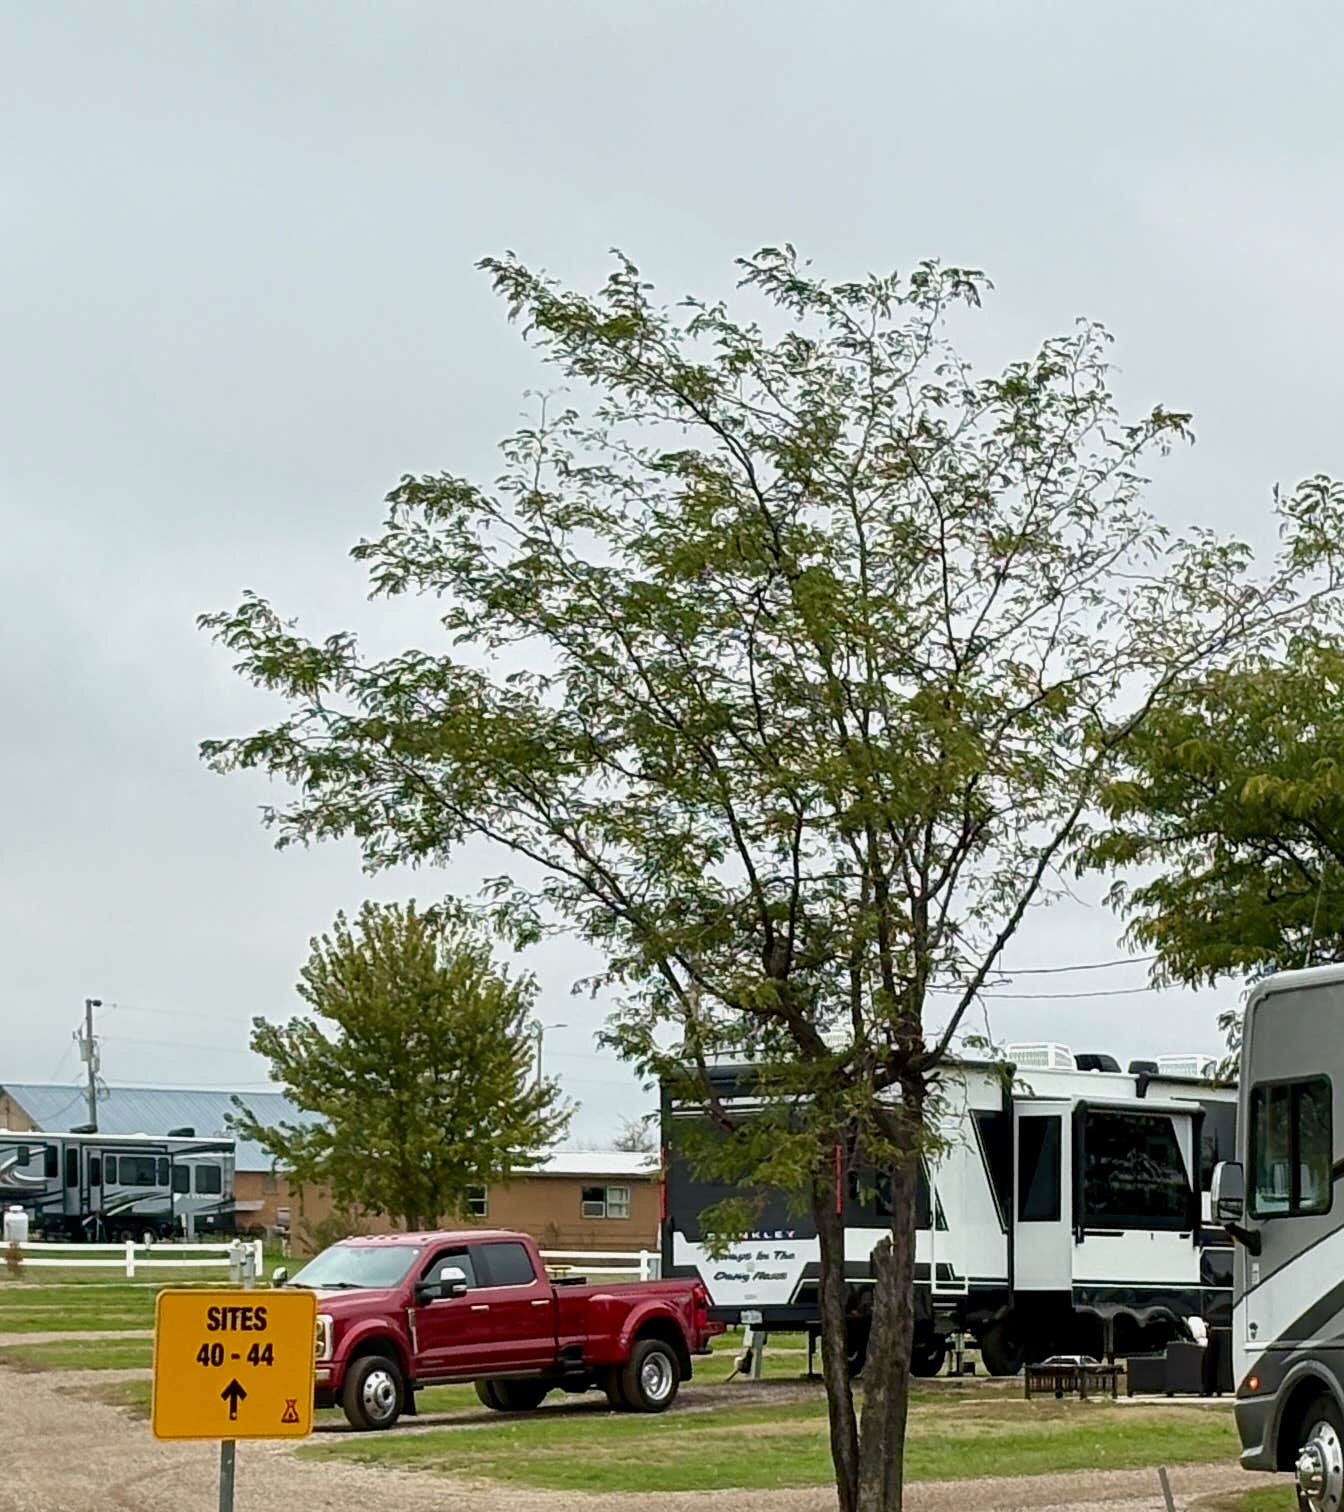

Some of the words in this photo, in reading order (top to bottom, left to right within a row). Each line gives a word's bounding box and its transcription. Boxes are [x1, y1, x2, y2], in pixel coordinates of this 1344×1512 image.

[774, 1250, 796, 1260] The
[207, 1306, 267, 1331] SITES
[196, 1342, 225, 1367] 40
[246, 1342, 274, 1367] 44
